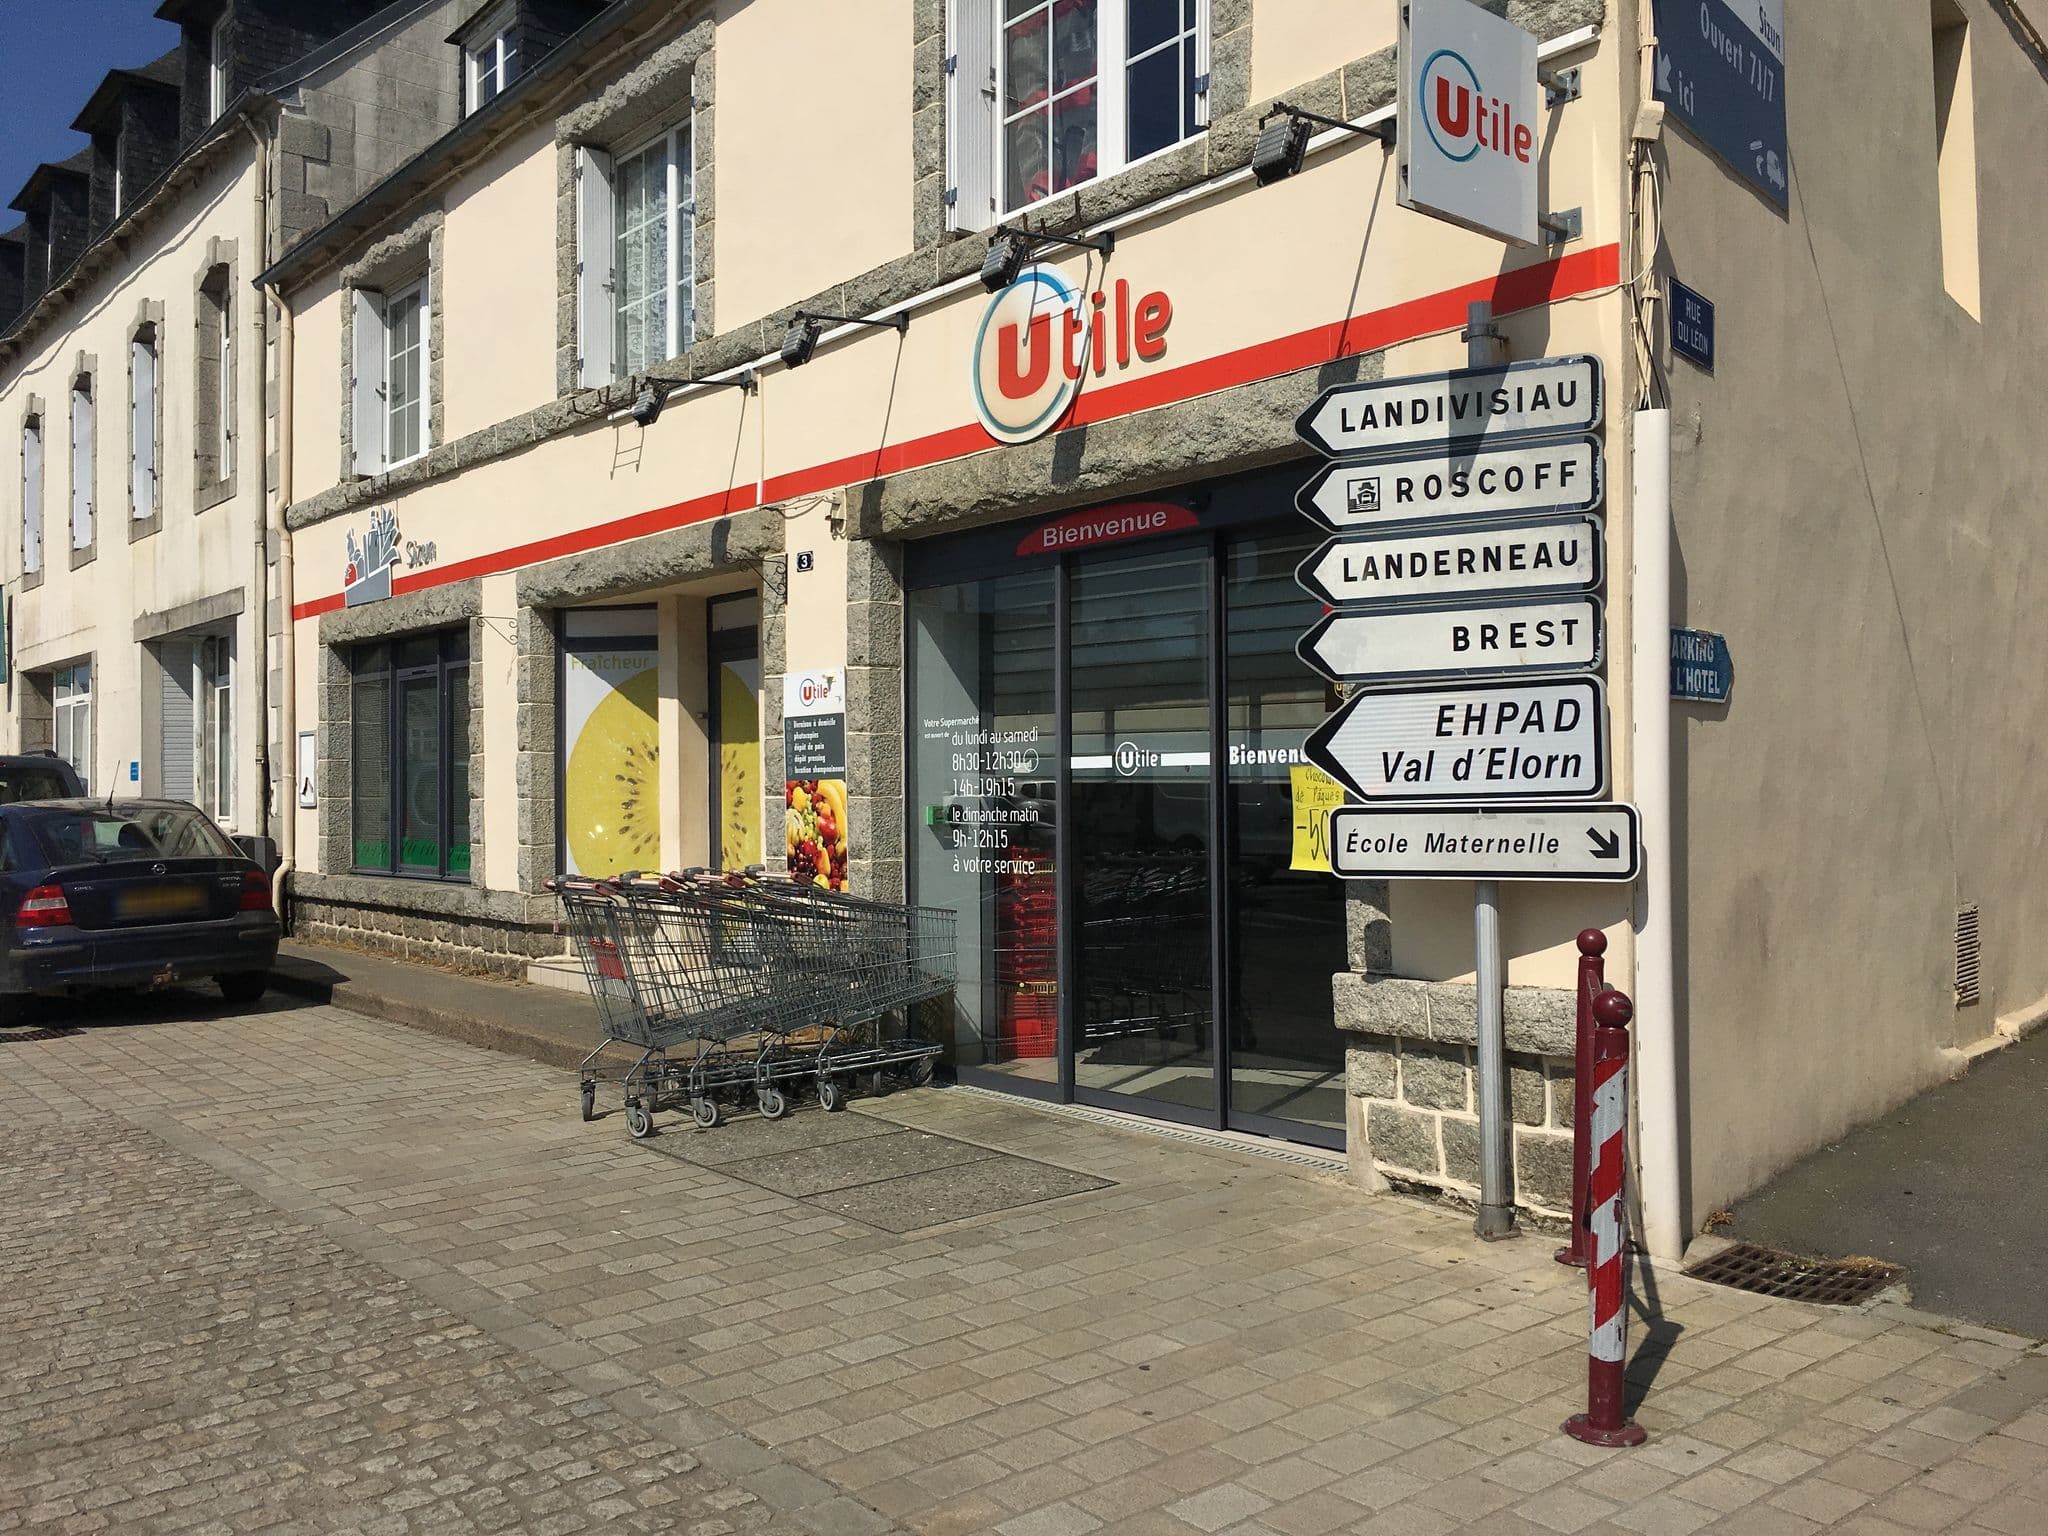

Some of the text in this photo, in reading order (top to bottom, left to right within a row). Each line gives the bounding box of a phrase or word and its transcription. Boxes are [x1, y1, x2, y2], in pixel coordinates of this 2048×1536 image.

[1700, 2, 1743, 74] Ouvert
[1758, 5, 1781, 55] Sizun
[1678, 70, 1695, 117] ici
[1436, 75, 1532, 164] Utile
[1685, 298, 1702, 325] RUE
[998, 278, 1171, 400] Utile
[1677, 320, 1690, 343] DU
[1340, 380, 1577, 433] LANDIVISIAU
[1396, 460, 1577, 503] ROSCOFF
[1043, 510, 1168, 547] Bienvenue
[801, 555, 808, 568] 3
[1343, 539, 1578, 583] LANDERNEAU
[1452, 619, 1579, 652] BREST
[1671, 634, 1714, 663] ARKING
[571, 654, 649, 671] Fraîcheur
[924, 715, 980, 729] Votre Supermarché
[1435, 698, 1581, 737] EHPAD
[951, 726, 1038, 746] du lundi au samedi
[952, 750, 1021, 771] 8h30-12h30
[1120, 749, 1159, 769] Utile
[1381, 747, 1582, 784] Val d'Elorn
[953, 777, 1015, 797] 14h-19h15
[952, 806, 1039, 822] le dimanche matin
[952, 829, 1008, 848] 9h-12h15
[1346, 828, 1559, 854] École Maternelle
[952, 854, 1035, 875] à votre service
